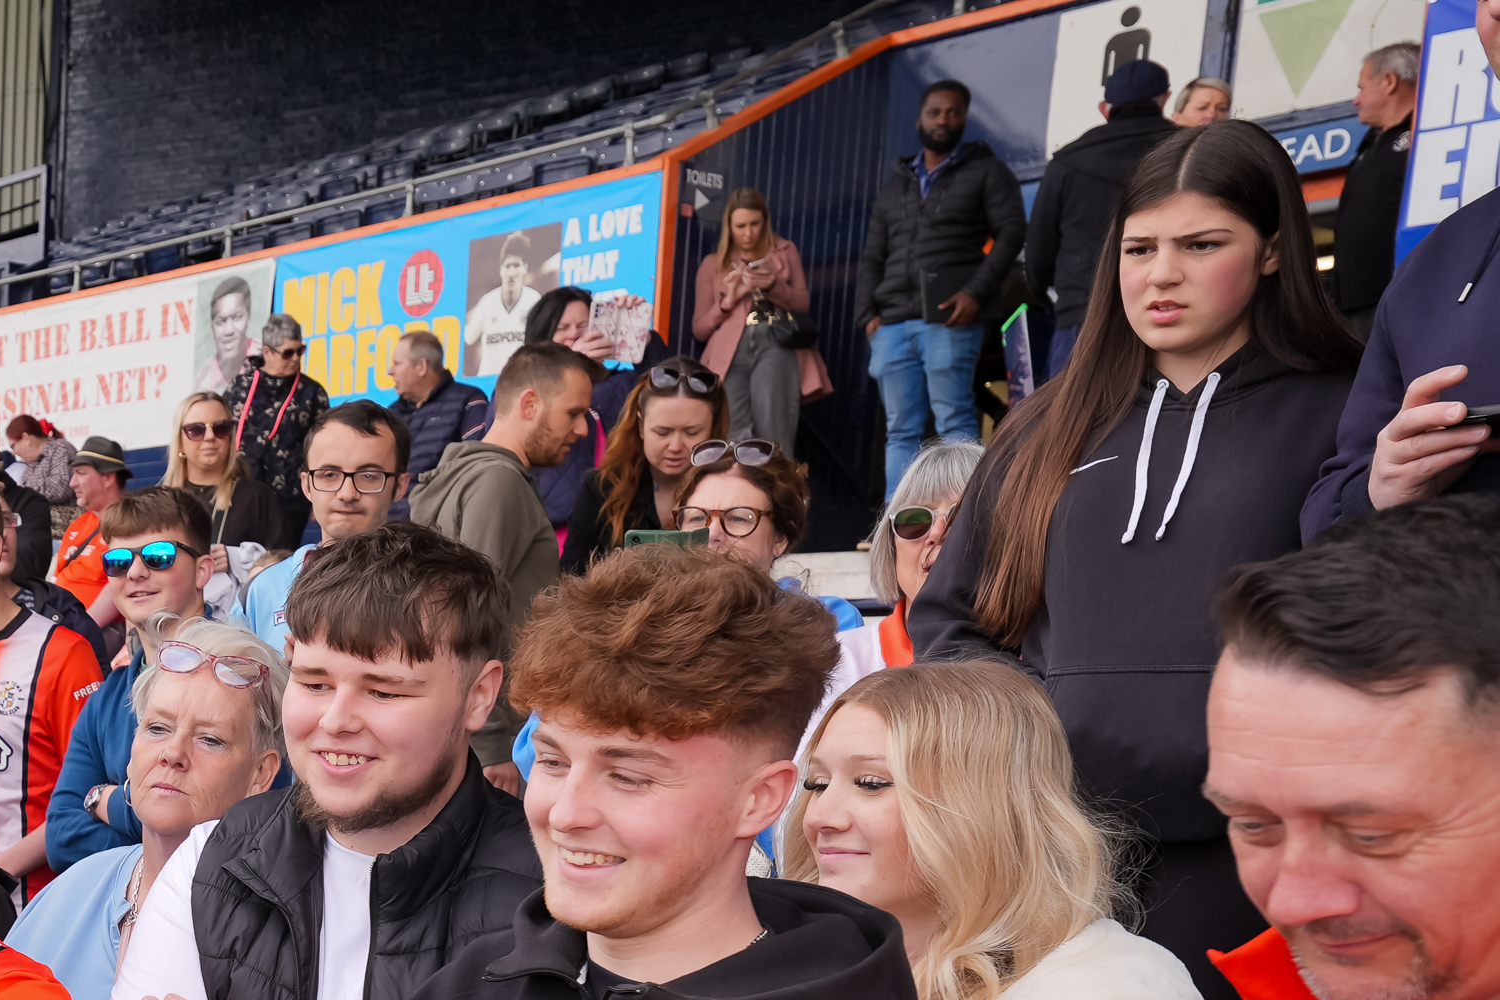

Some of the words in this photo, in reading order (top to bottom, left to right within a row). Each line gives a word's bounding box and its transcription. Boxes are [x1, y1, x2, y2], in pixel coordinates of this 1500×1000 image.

[686, 168, 724, 190] TOILETS
[563, 217, 582, 246] A
[588, 204, 644, 242] LOVE
[563, 249, 619, 286] THAT
[283, 260, 385, 337] MICK
[16, 322, 70, 364] THE
[79, 307, 151, 352] BALL
[159, 299, 194, 338] IN
[94, 364, 168, 408] NET?
